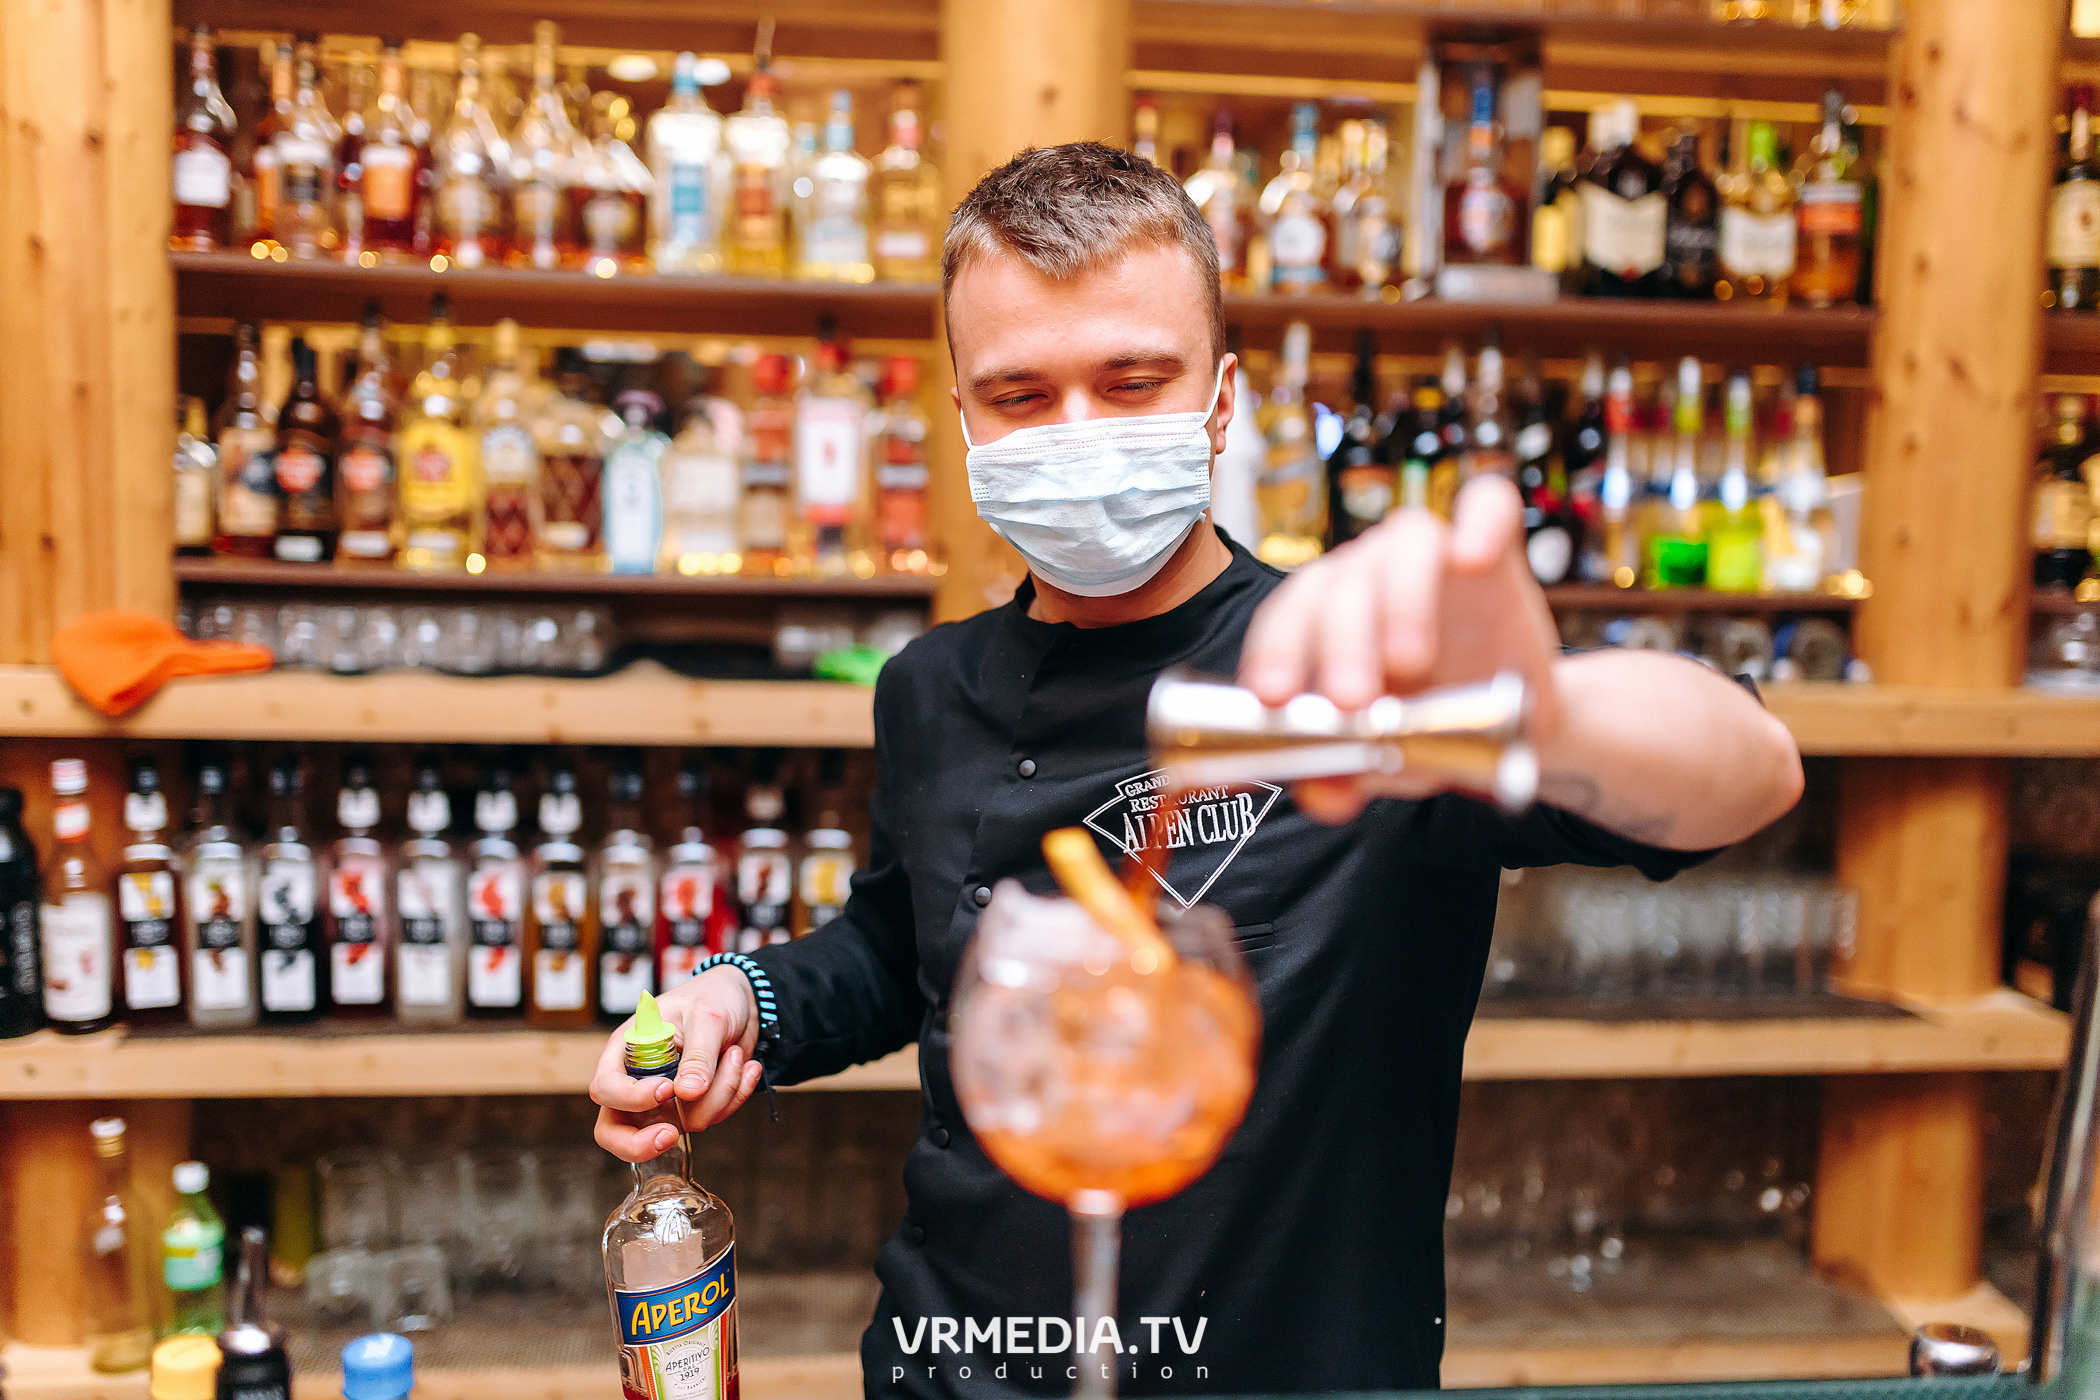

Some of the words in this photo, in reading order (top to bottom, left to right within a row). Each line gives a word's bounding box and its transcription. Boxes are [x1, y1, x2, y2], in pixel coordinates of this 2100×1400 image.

[1124, 775, 1170, 798] GRAND
[1129, 784, 1229, 813] RESTURANT
[1196, 792, 1256, 844] CLUB
[631, 1272, 730, 1336] APEROL
[665, 1346, 710, 1372] APERITIVO
[680, 1367, 700, 1381] 1919
